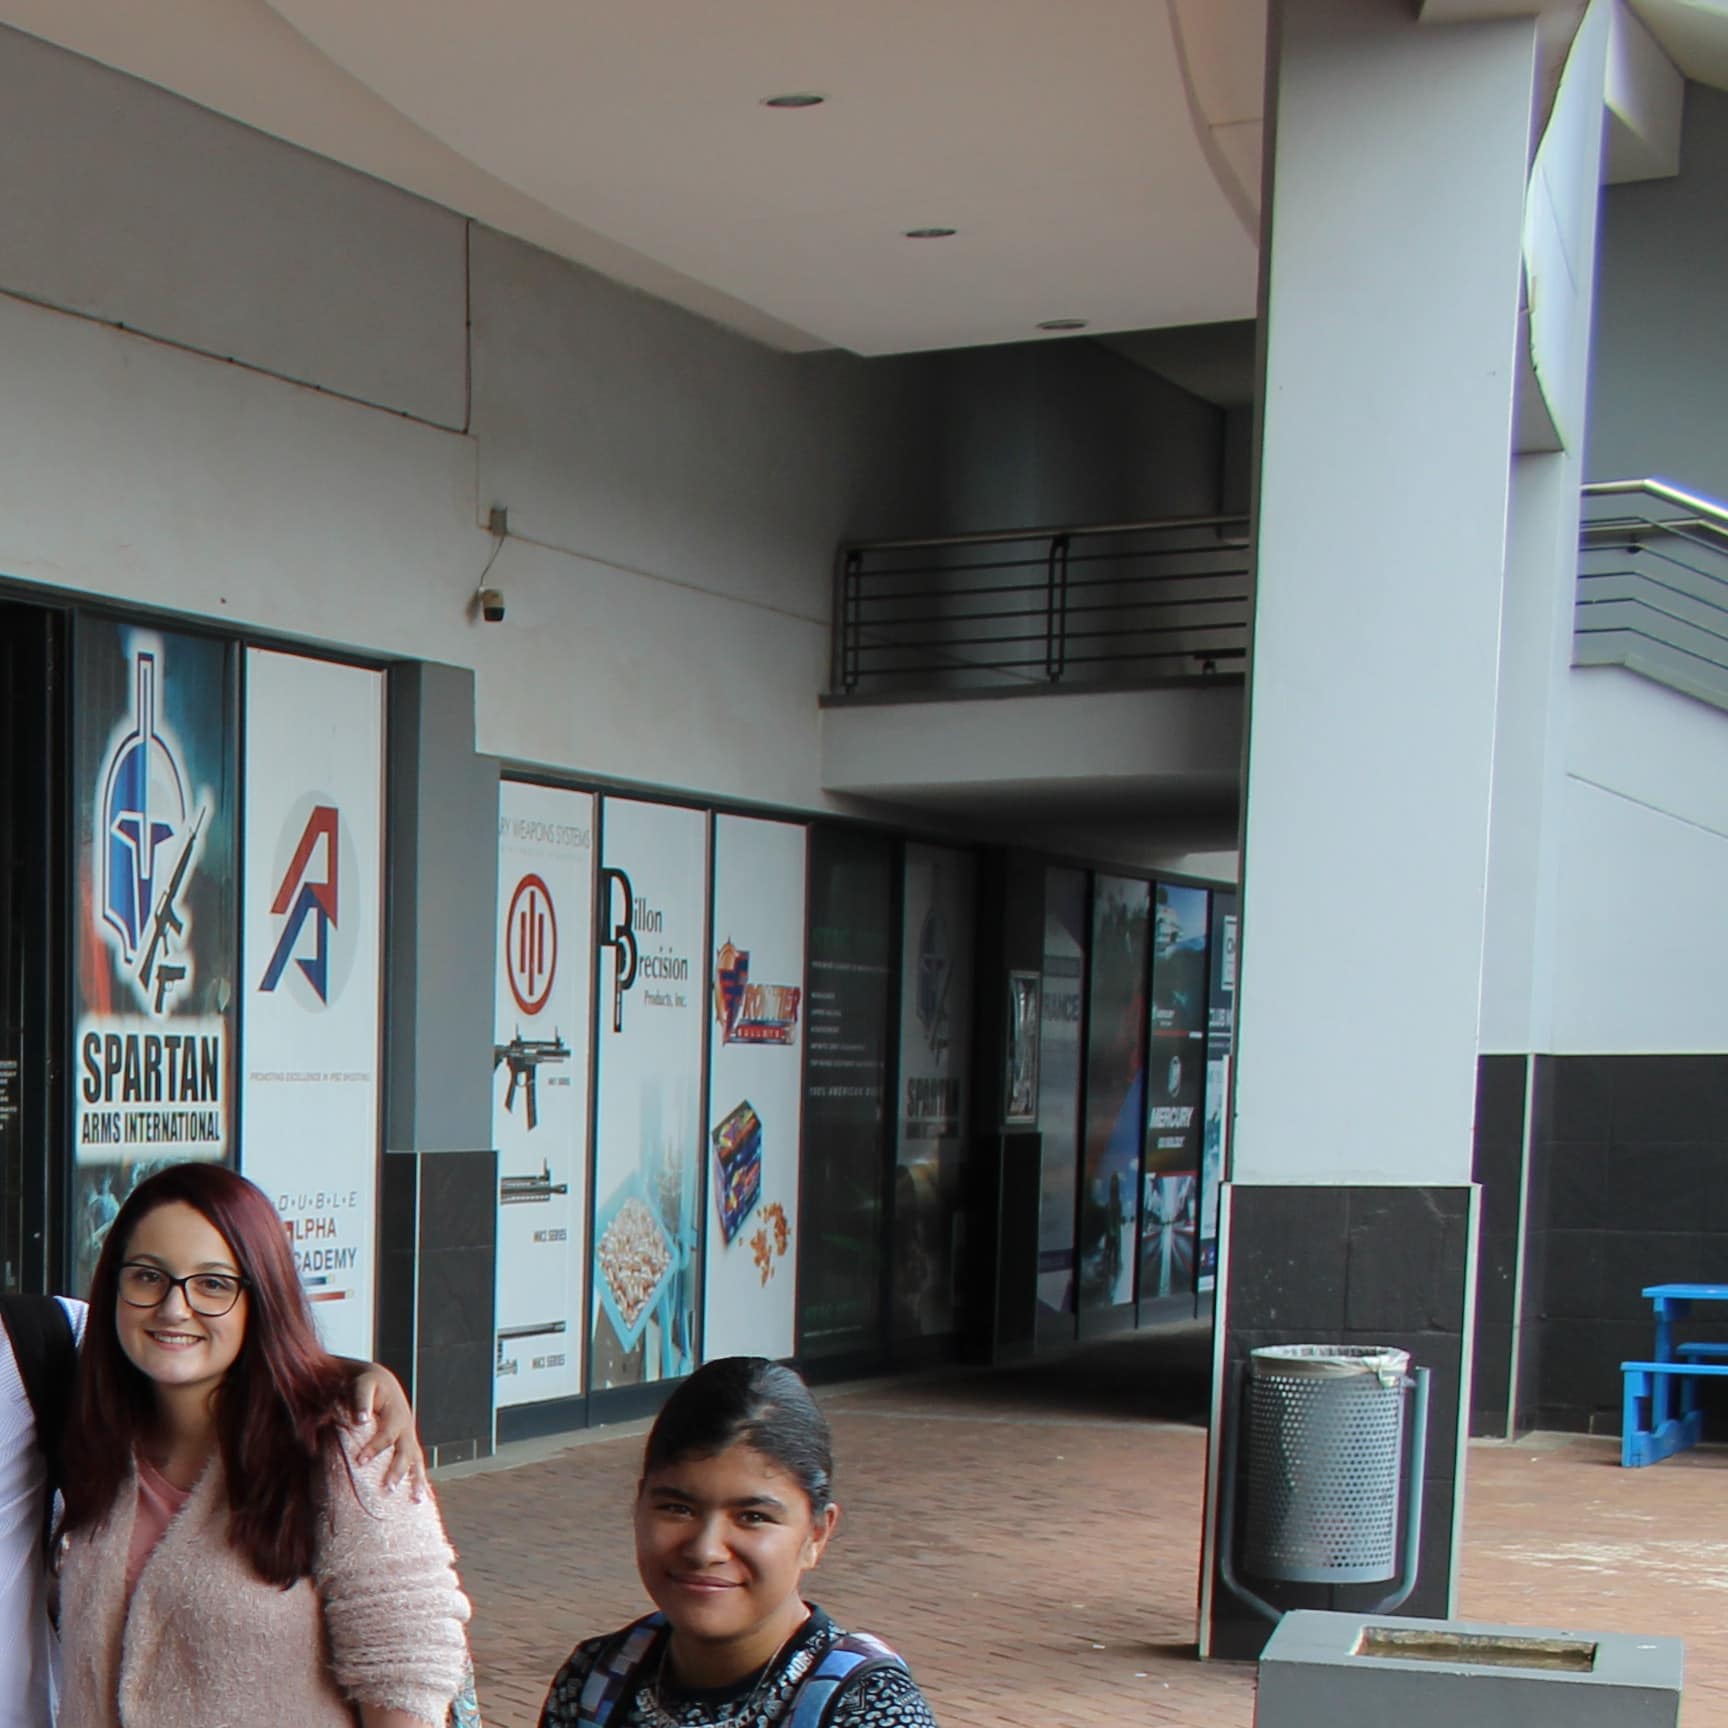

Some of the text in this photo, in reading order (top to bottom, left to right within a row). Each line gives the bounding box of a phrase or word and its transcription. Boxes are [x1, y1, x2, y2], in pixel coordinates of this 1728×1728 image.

[81, 1031, 220, 1104] SPARTAN
[81, 1110, 220, 1144] ARMS INTERNATIONAL
